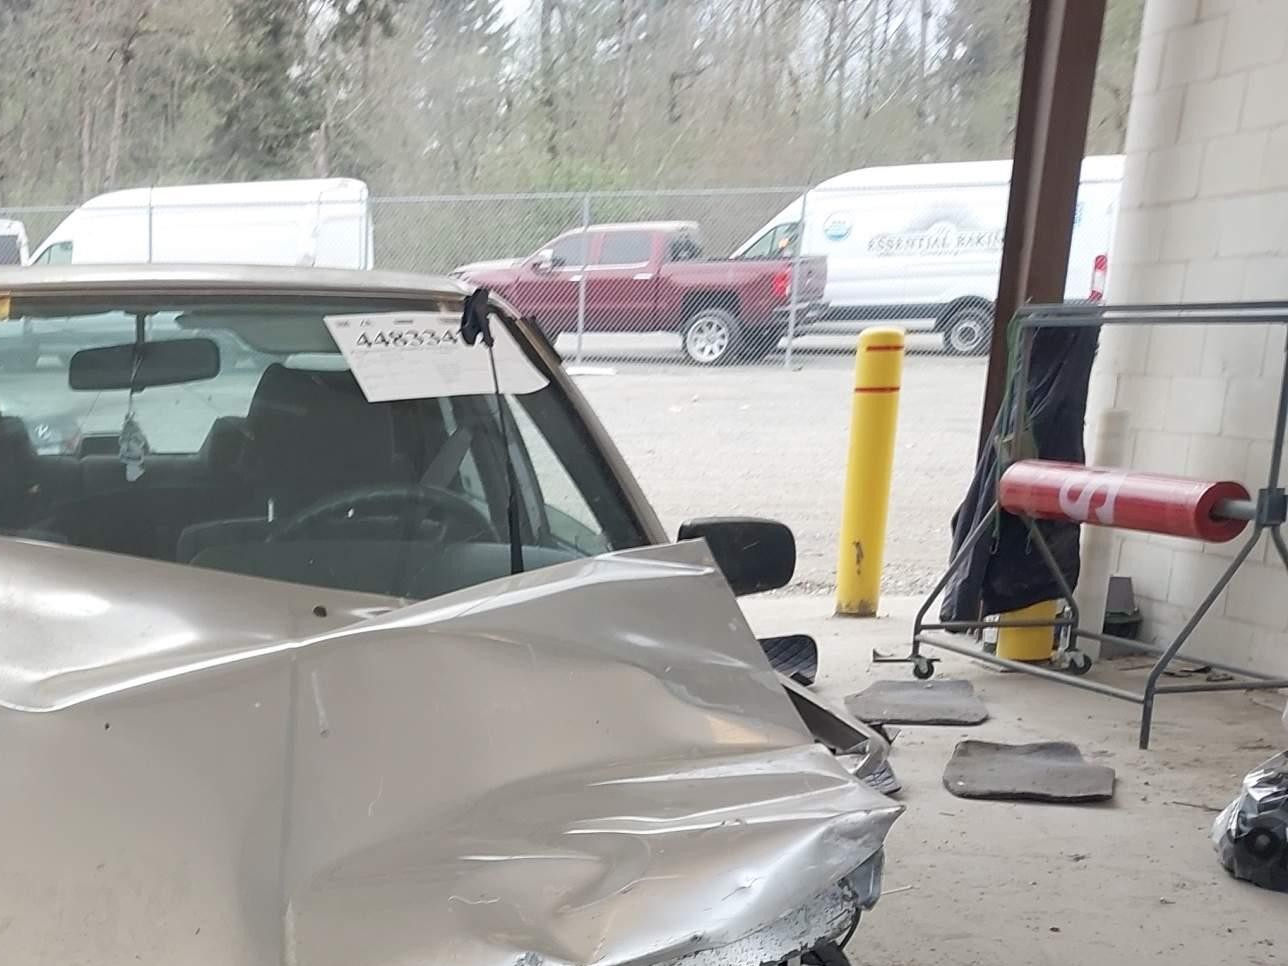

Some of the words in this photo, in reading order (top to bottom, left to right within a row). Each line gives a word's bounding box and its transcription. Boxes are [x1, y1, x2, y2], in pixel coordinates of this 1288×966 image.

[867, 232, 951, 250] ESSENTIAL
[956, 230, 1005, 249] BAKIN
[357, 328, 463, 347] 448334
